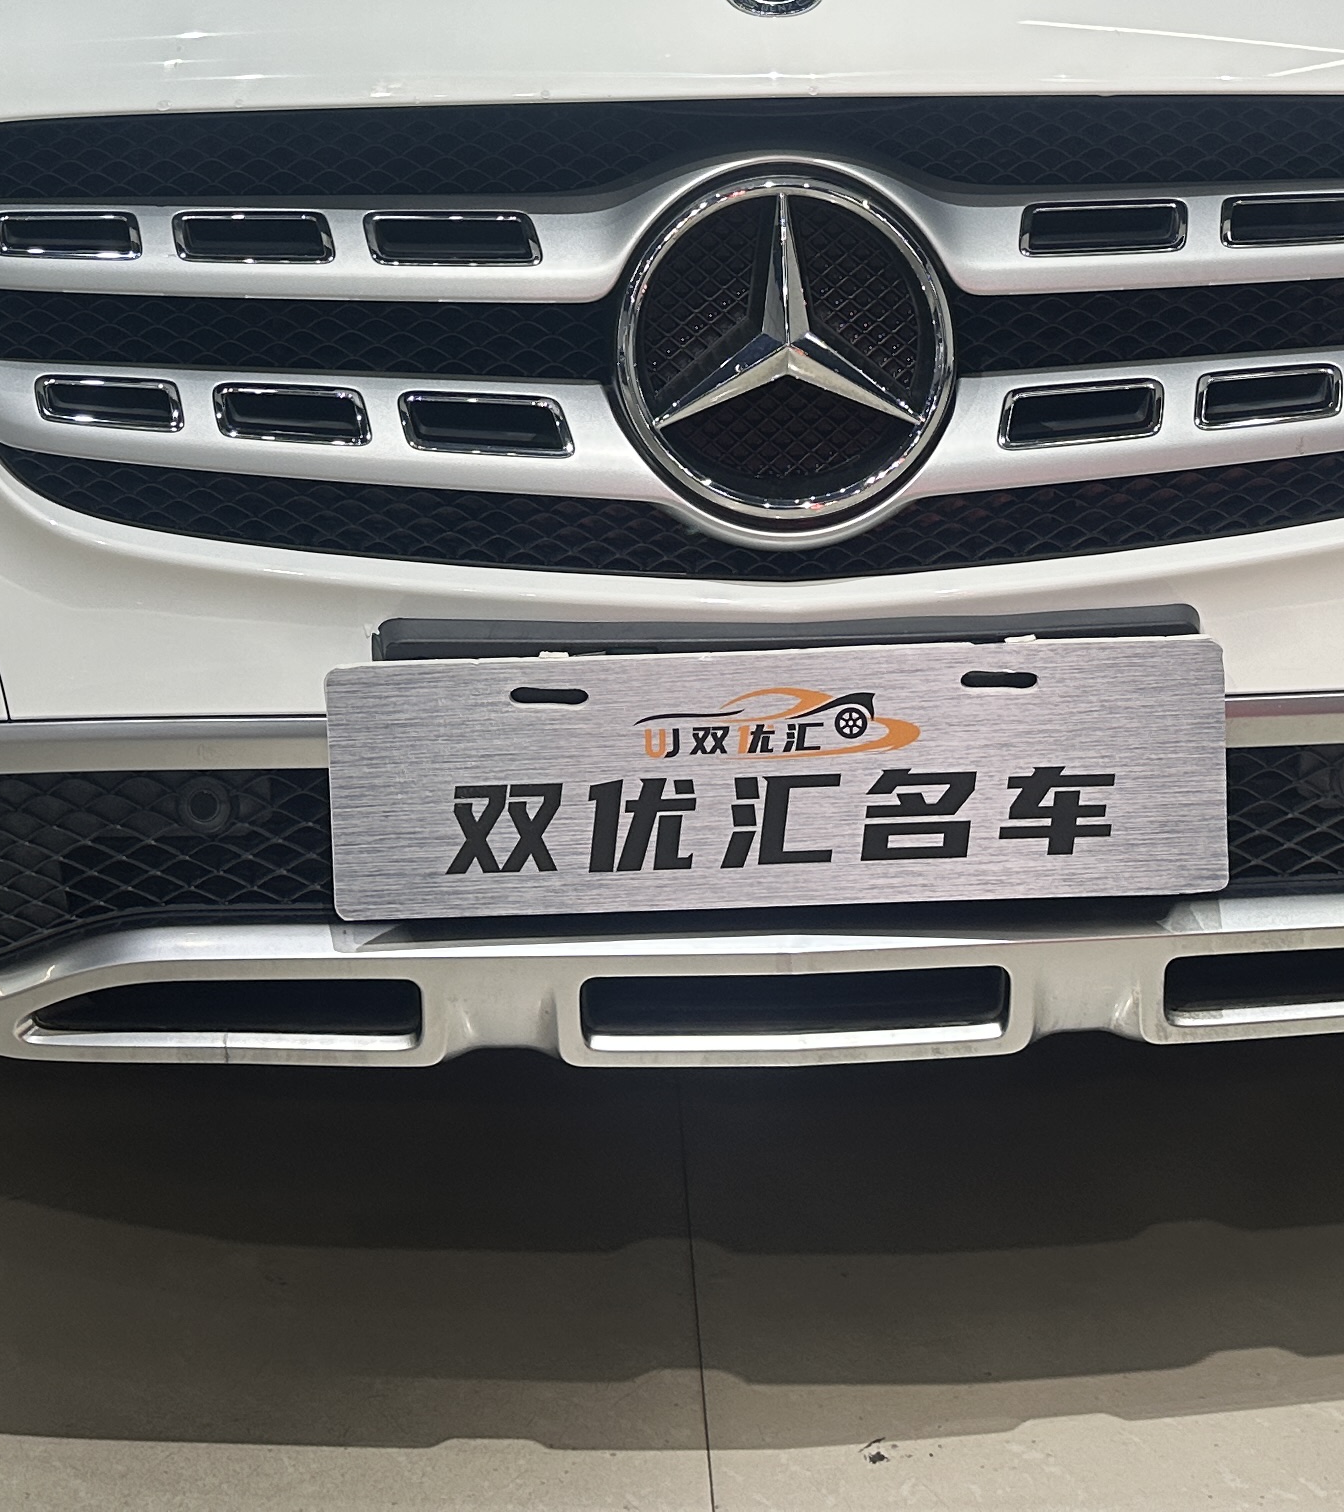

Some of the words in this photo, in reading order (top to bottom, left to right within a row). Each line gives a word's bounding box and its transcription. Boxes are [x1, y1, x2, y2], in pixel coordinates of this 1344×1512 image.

[445, 766, 1117, 875] 双优汇名车
